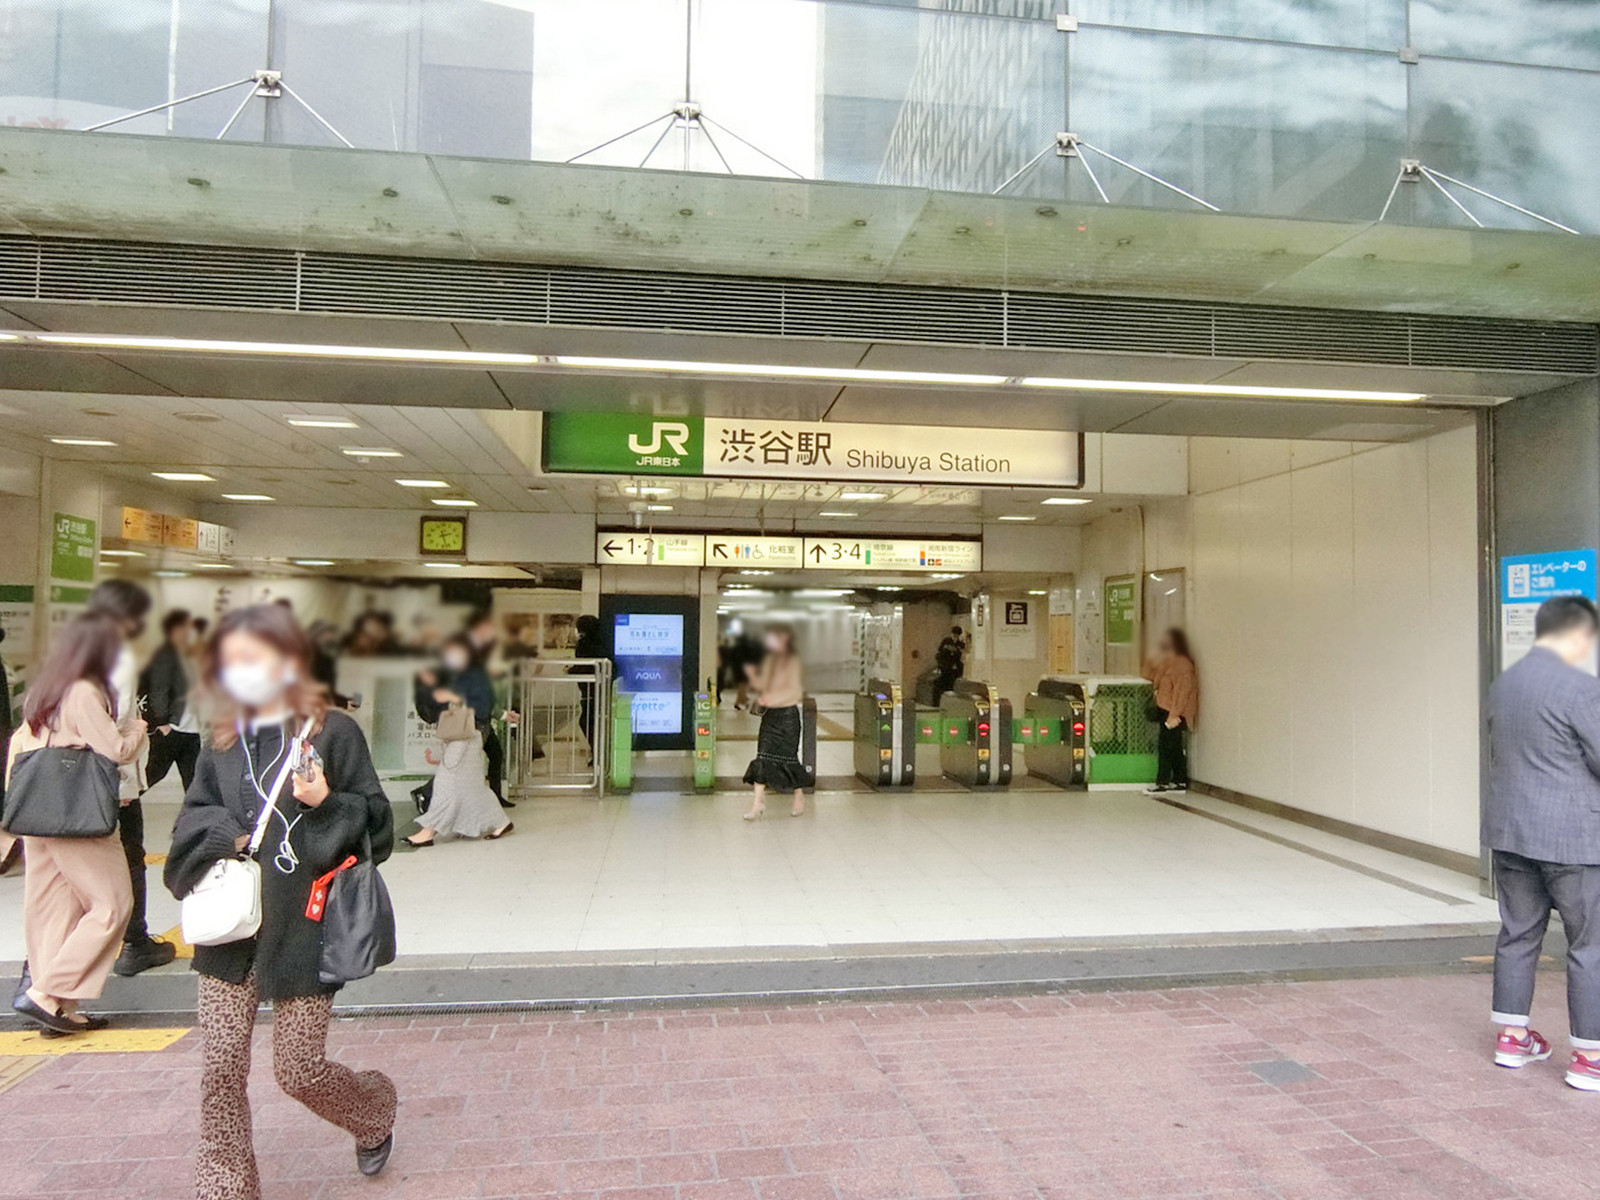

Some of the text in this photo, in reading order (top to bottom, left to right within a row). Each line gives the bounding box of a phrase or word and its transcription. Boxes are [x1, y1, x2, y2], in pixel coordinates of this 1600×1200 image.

[629, 422, 689, 456] JR
[720, 428, 832, 467] 渋谷駅
[636, 456, 681, 467] JR東日本
[847, 449, 1011, 474] Shibuya Station
[1531, 560, 1587, 574] エレベーターの
[635, 672, 662, 680] AQUA
[697, 702, 711, 711] IC
